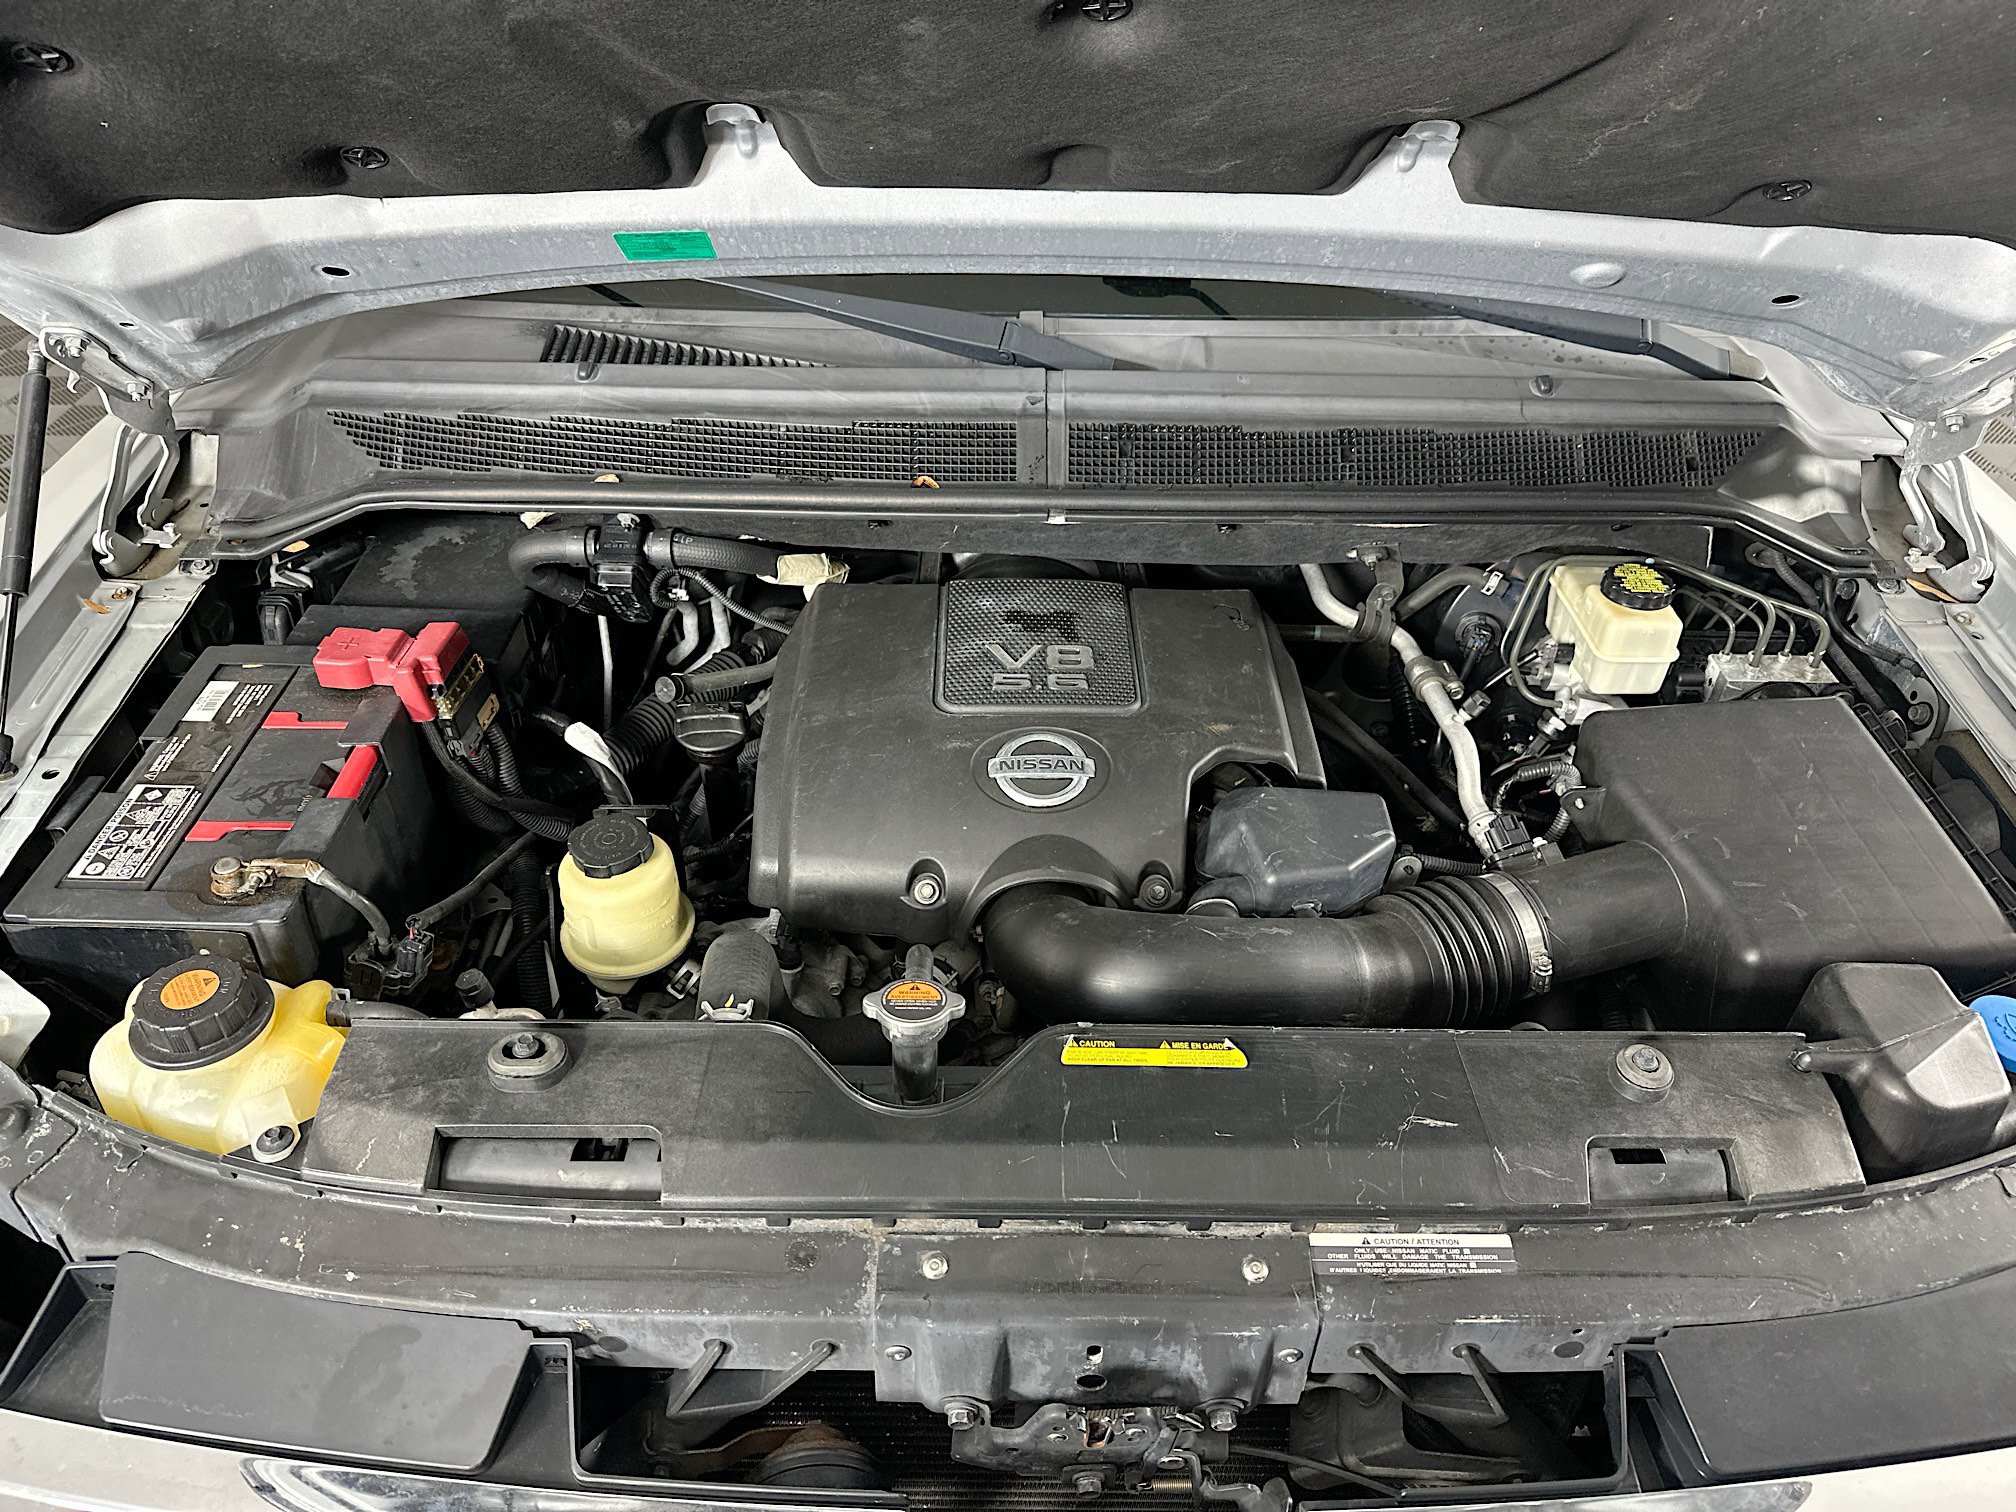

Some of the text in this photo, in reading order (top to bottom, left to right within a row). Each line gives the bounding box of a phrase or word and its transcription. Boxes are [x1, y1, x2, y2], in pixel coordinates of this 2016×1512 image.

[984, 644, 1095, 670] V8
[992, 672, 1089, 690] 5.6
[999, 759, 1084, 770] NISSAN
